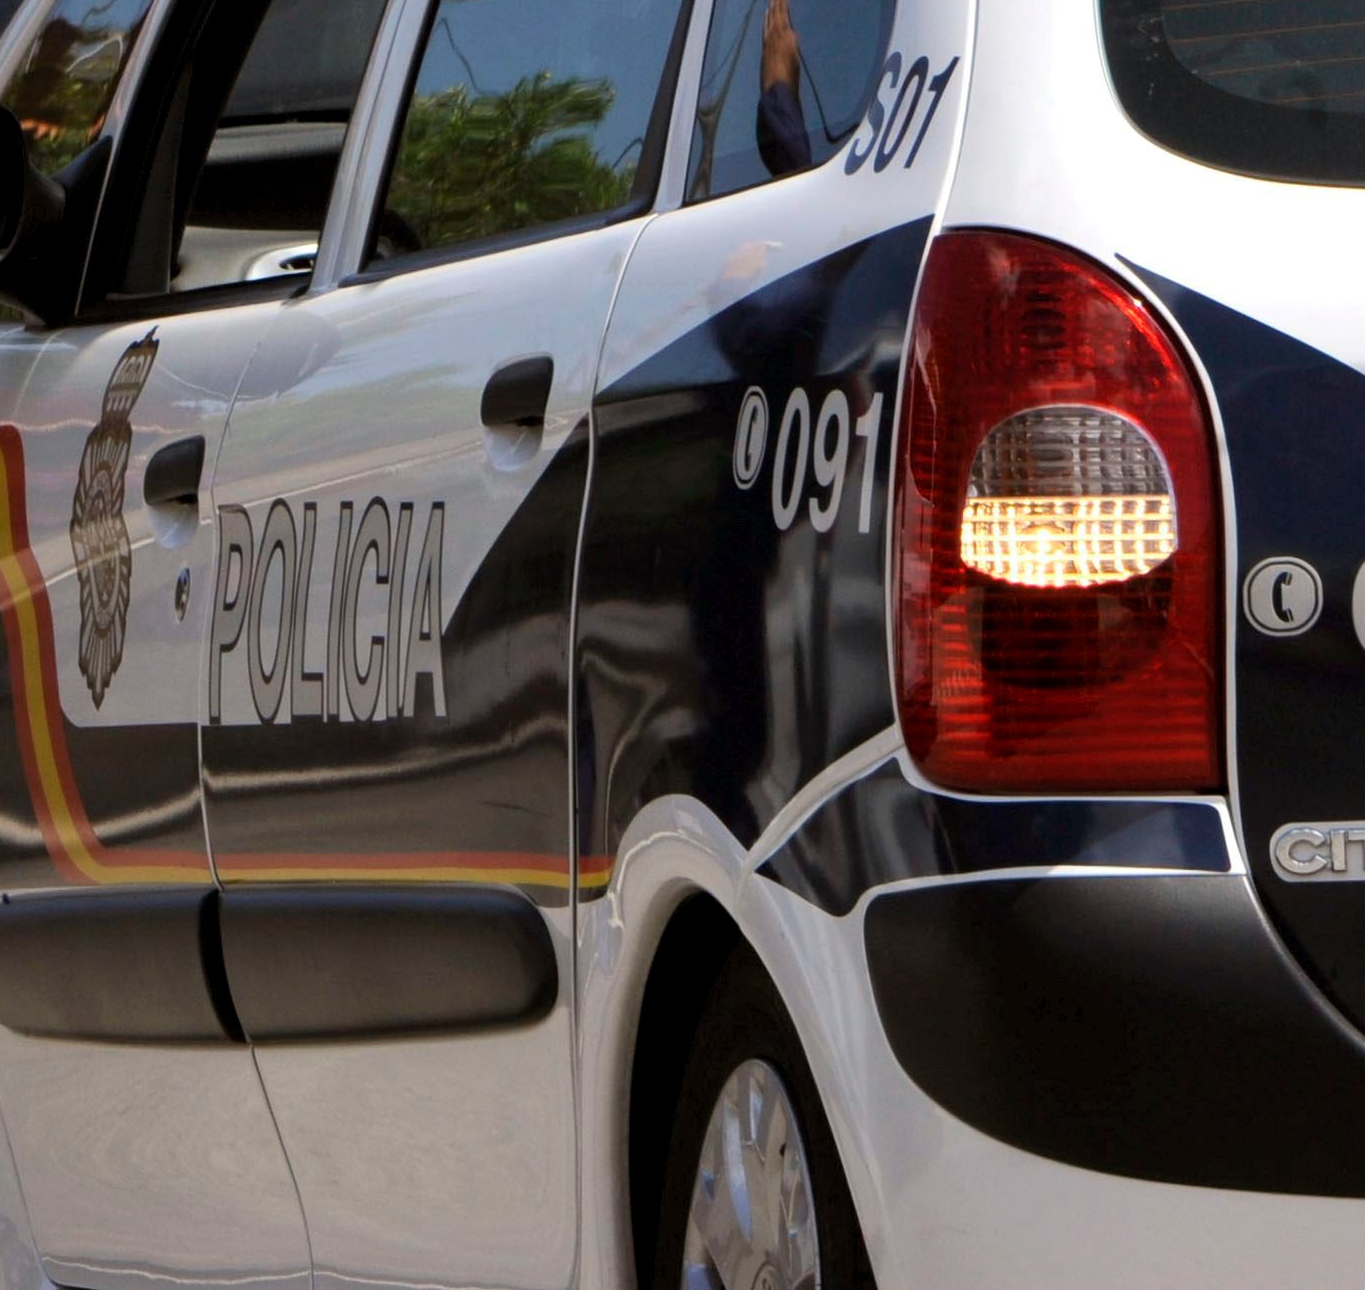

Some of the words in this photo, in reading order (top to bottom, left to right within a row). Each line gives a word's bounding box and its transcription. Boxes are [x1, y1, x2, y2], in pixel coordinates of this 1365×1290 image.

[844, 51, 960, 176] S01
[772, 387, 884, 534] 091
[209, 496, 448, 725] POLICIA
